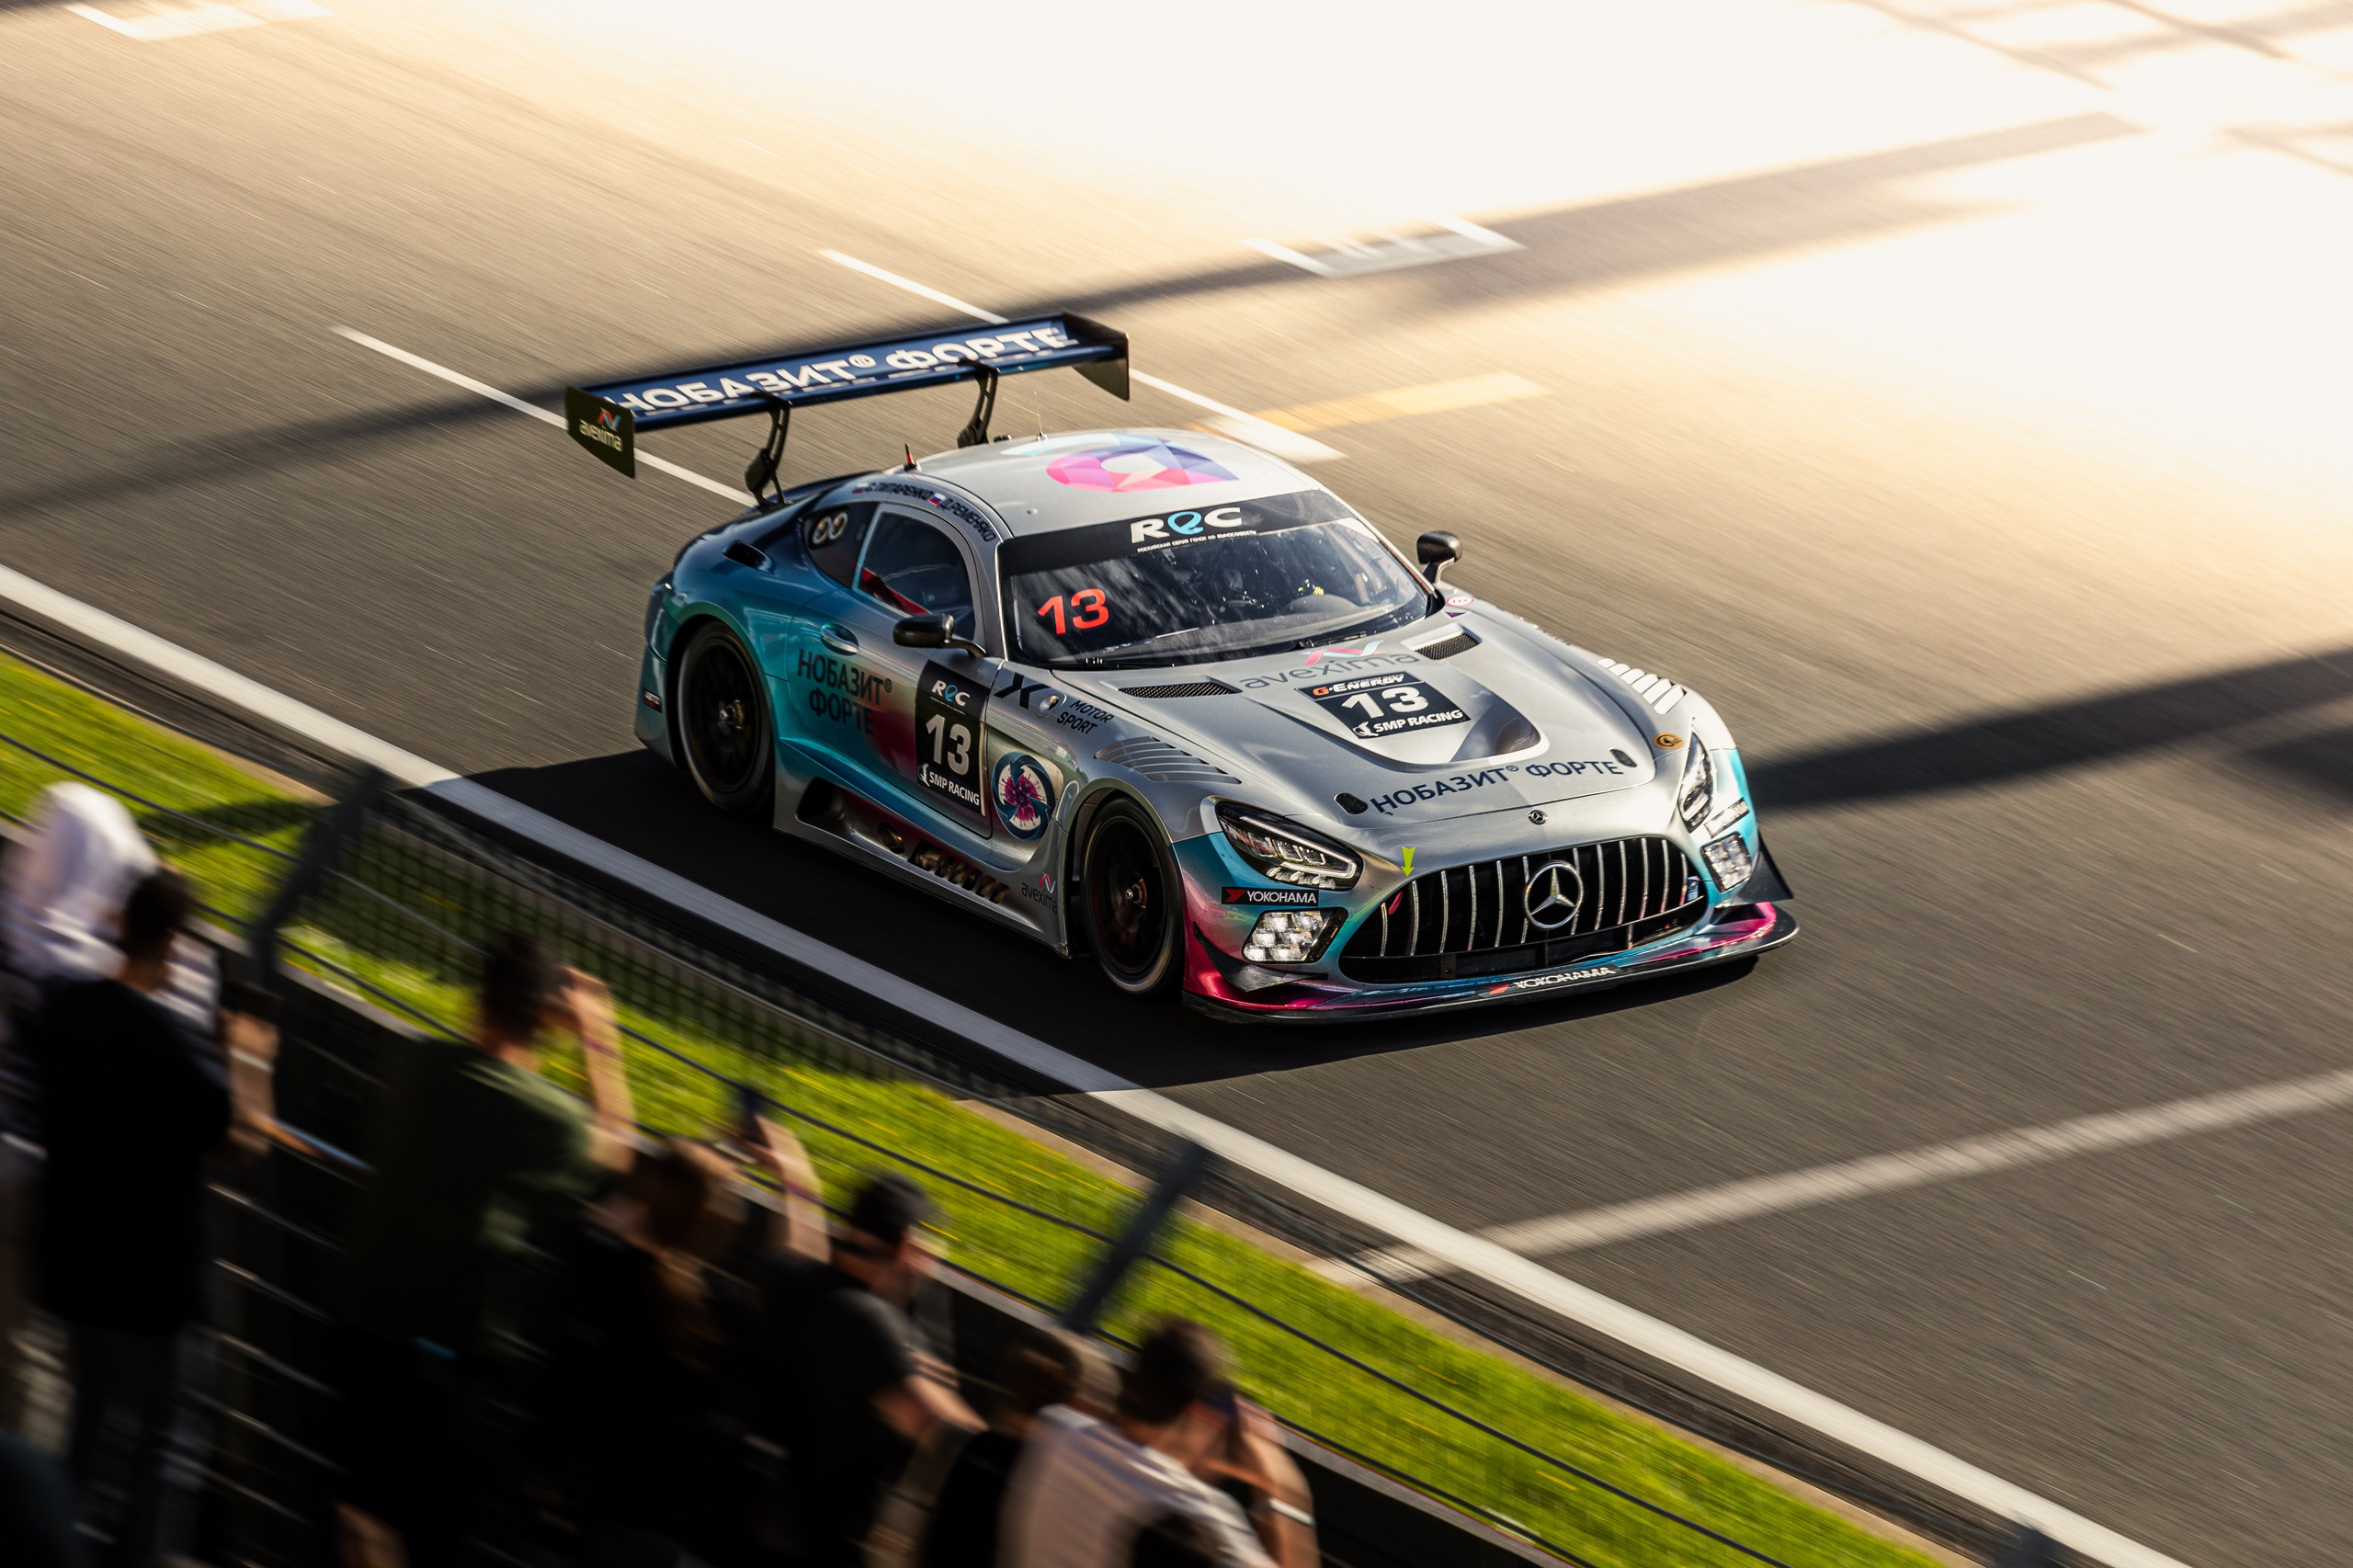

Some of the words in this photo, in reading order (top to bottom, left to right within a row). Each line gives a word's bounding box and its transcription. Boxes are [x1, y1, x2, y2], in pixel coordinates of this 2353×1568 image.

[885, 326, 1074, 369] ФОРТЕ
[1037, 587, 1109, 635] 13
[1239, 653, 1421, 689] avexima
[809, 687, 874, 736] ФОРТЕ
[1069, 699, 1115, 723] MOTOR
[1341, 686, 1429, 719] 13
[1057, 711, 1098, 734] SPORT
[1372, 720, 1407, 733] SMP
[1408, 710, 1464, 726] RACING
[926, 713, 972, 776] 13
[1525, 760, 1625, 778] ФОРТЕ
[928, 771, 948, 790] SMP
[948, 780, 981, 807] RACING
[1021, 882, 1058, 915] avexima
[1246, 890, 1317, 904] YOKOHAMA
[1513, 967, 1617, 989] YOKOHAMA
